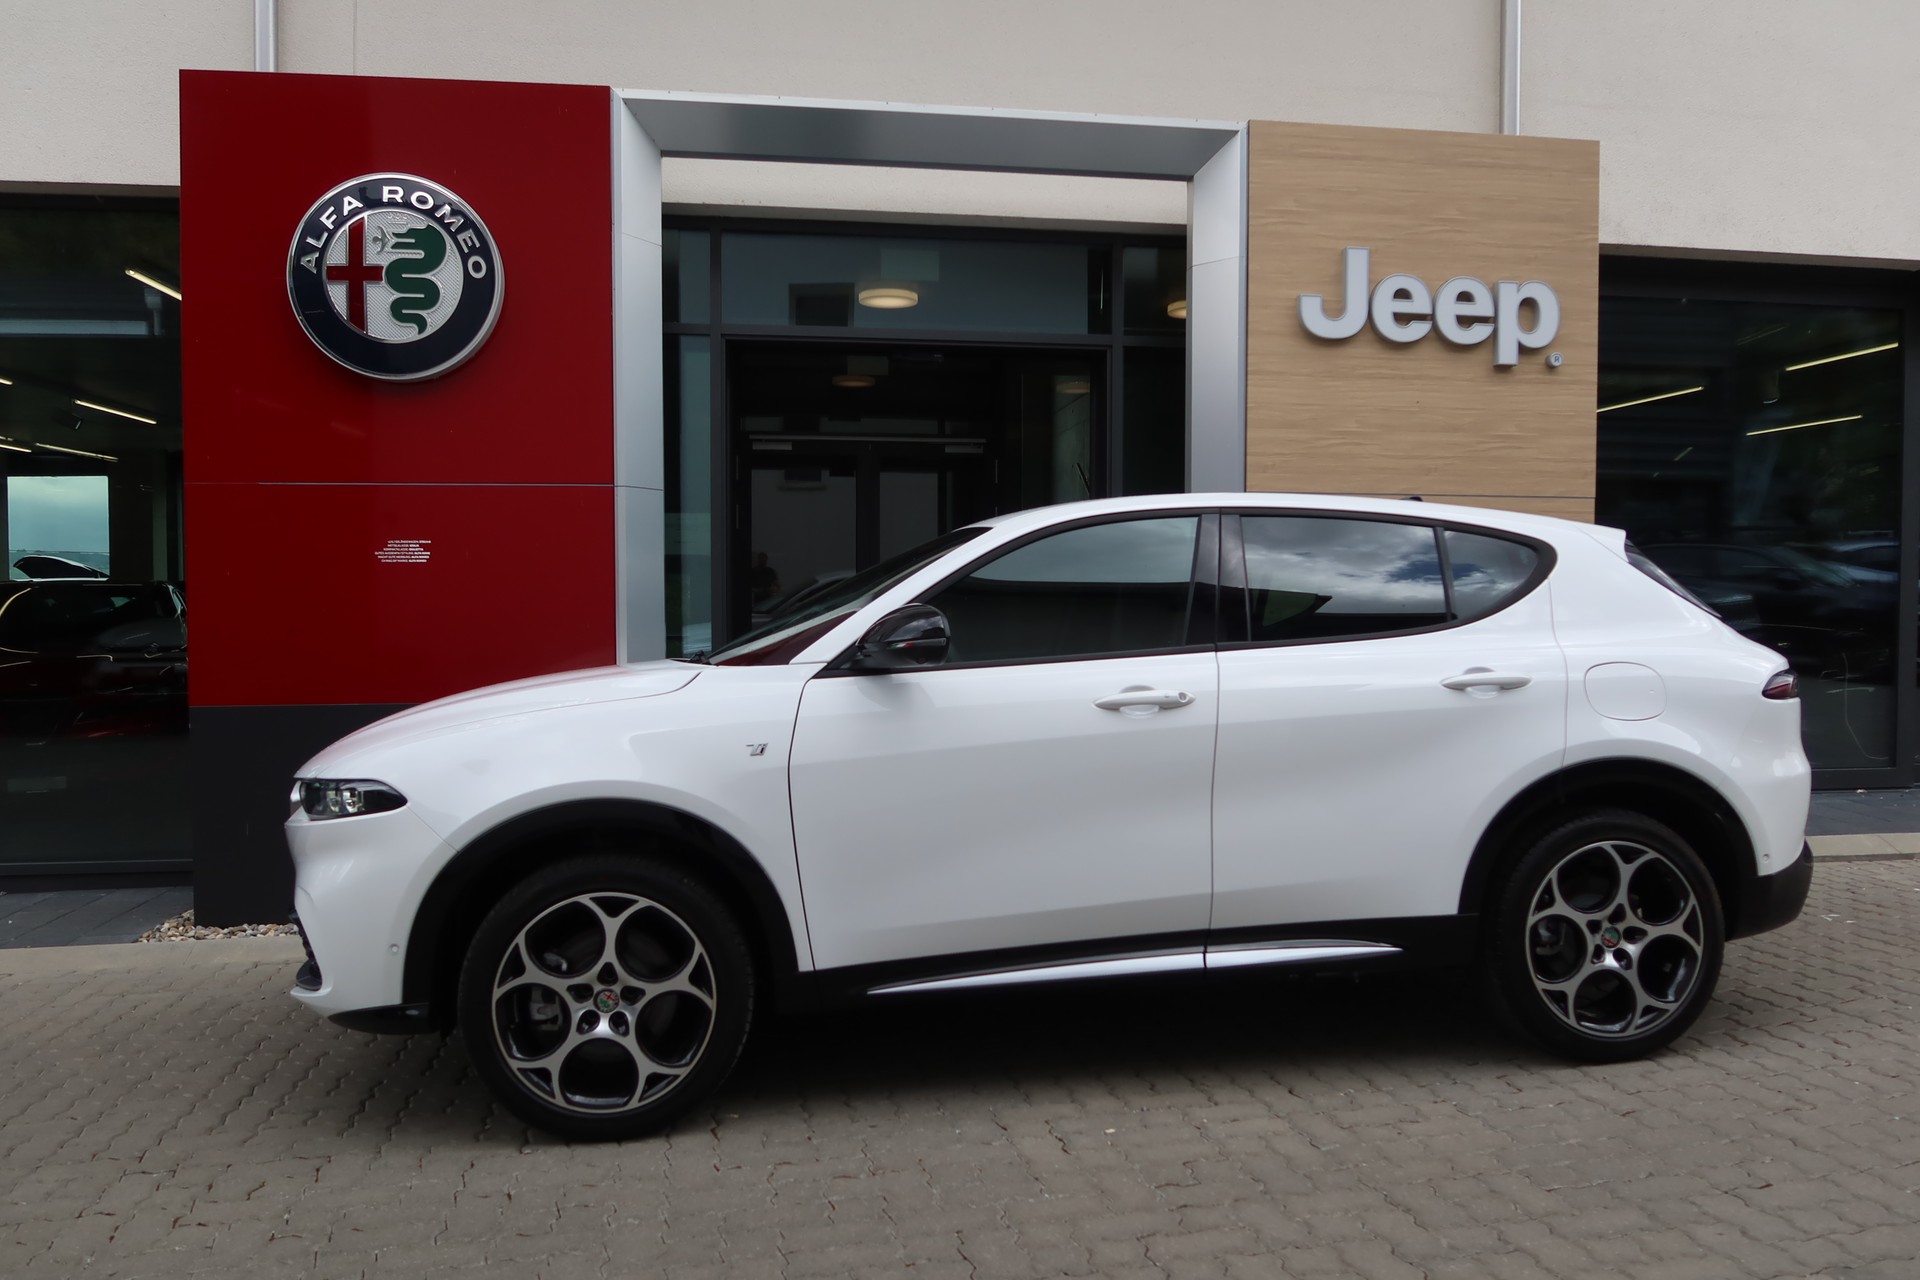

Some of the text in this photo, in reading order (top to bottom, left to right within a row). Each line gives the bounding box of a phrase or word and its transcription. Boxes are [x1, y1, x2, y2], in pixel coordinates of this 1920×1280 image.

[301, 185, 487, 279] ALFA ROMEO
[1297, 246, 1560, 367] Jeep
